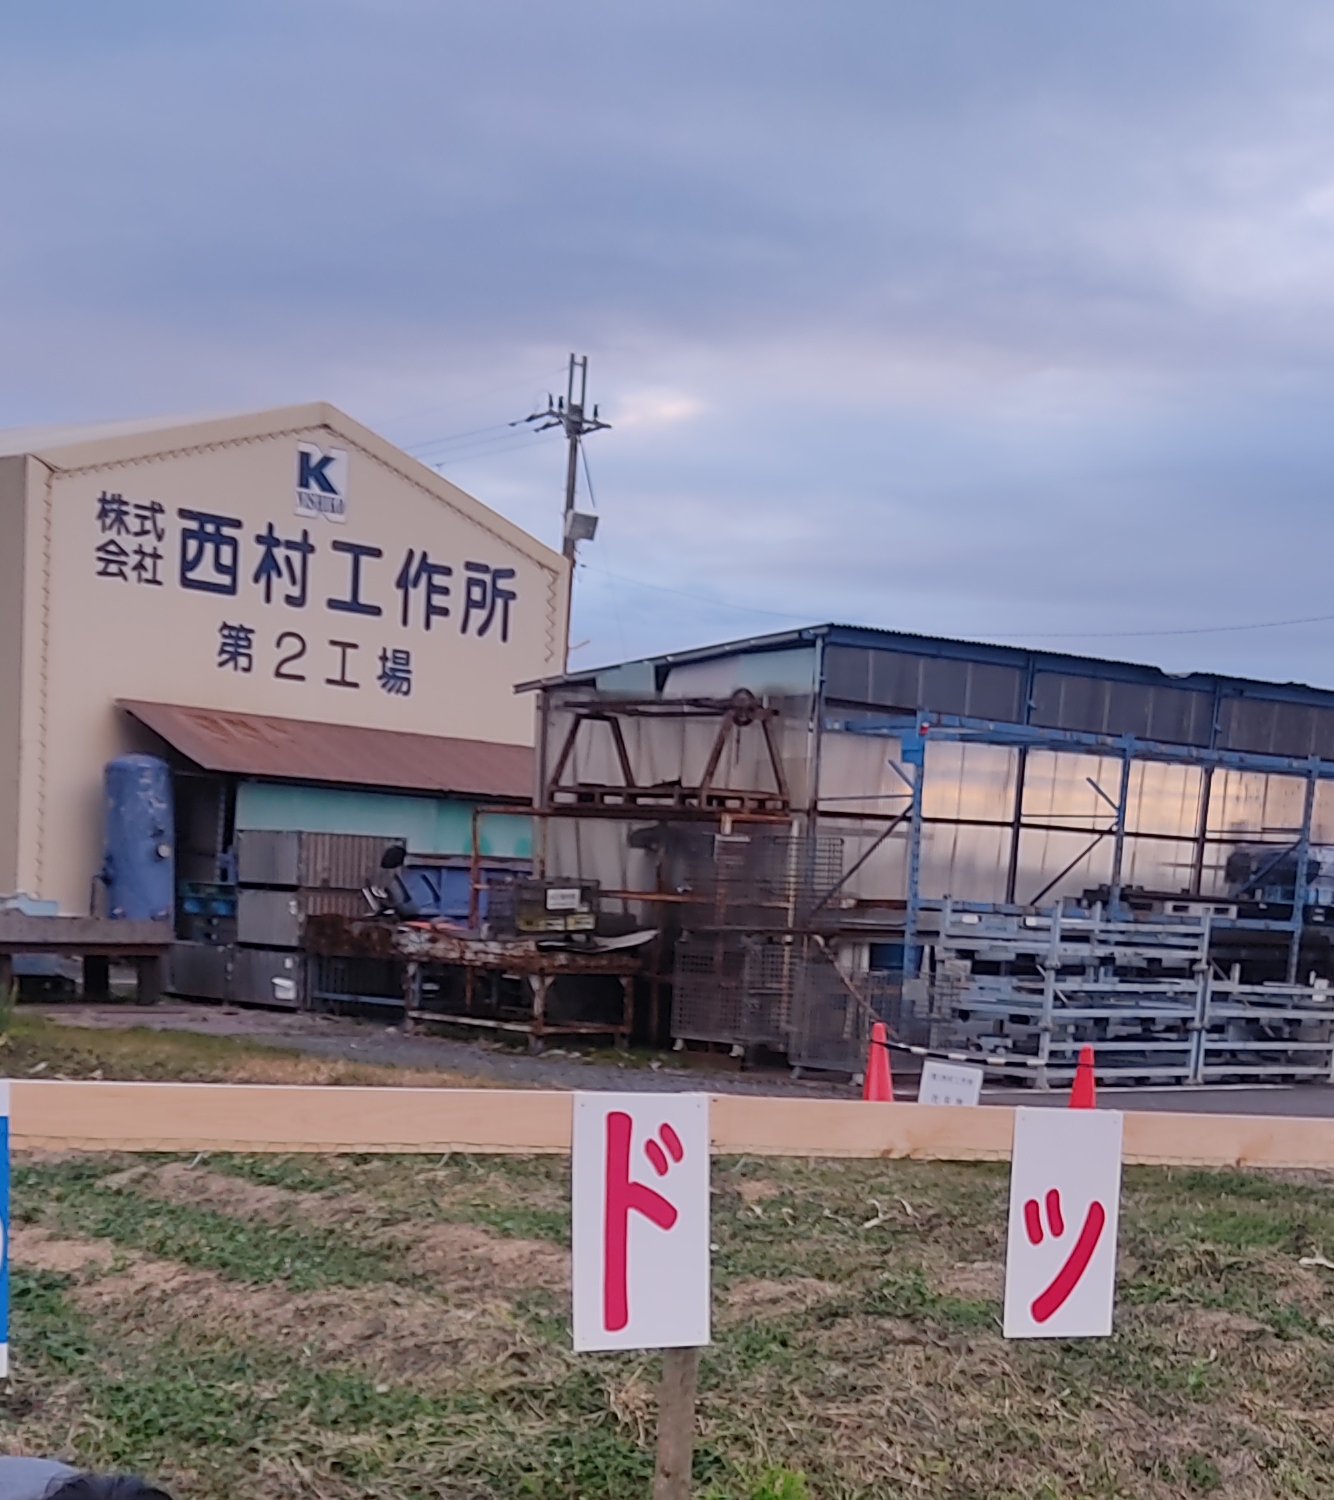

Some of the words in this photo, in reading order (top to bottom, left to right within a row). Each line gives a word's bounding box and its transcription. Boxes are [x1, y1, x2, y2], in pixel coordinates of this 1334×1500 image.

[299, 450, 338, 495] K
[95, 491, 165, 542] 株式
[95, 539, 164, 587] 会社
[177, 507, 518, 643] 西村工作所
[216, 622, 413, 697] 第2工場
[604, 1112, 685, 1332] ド
